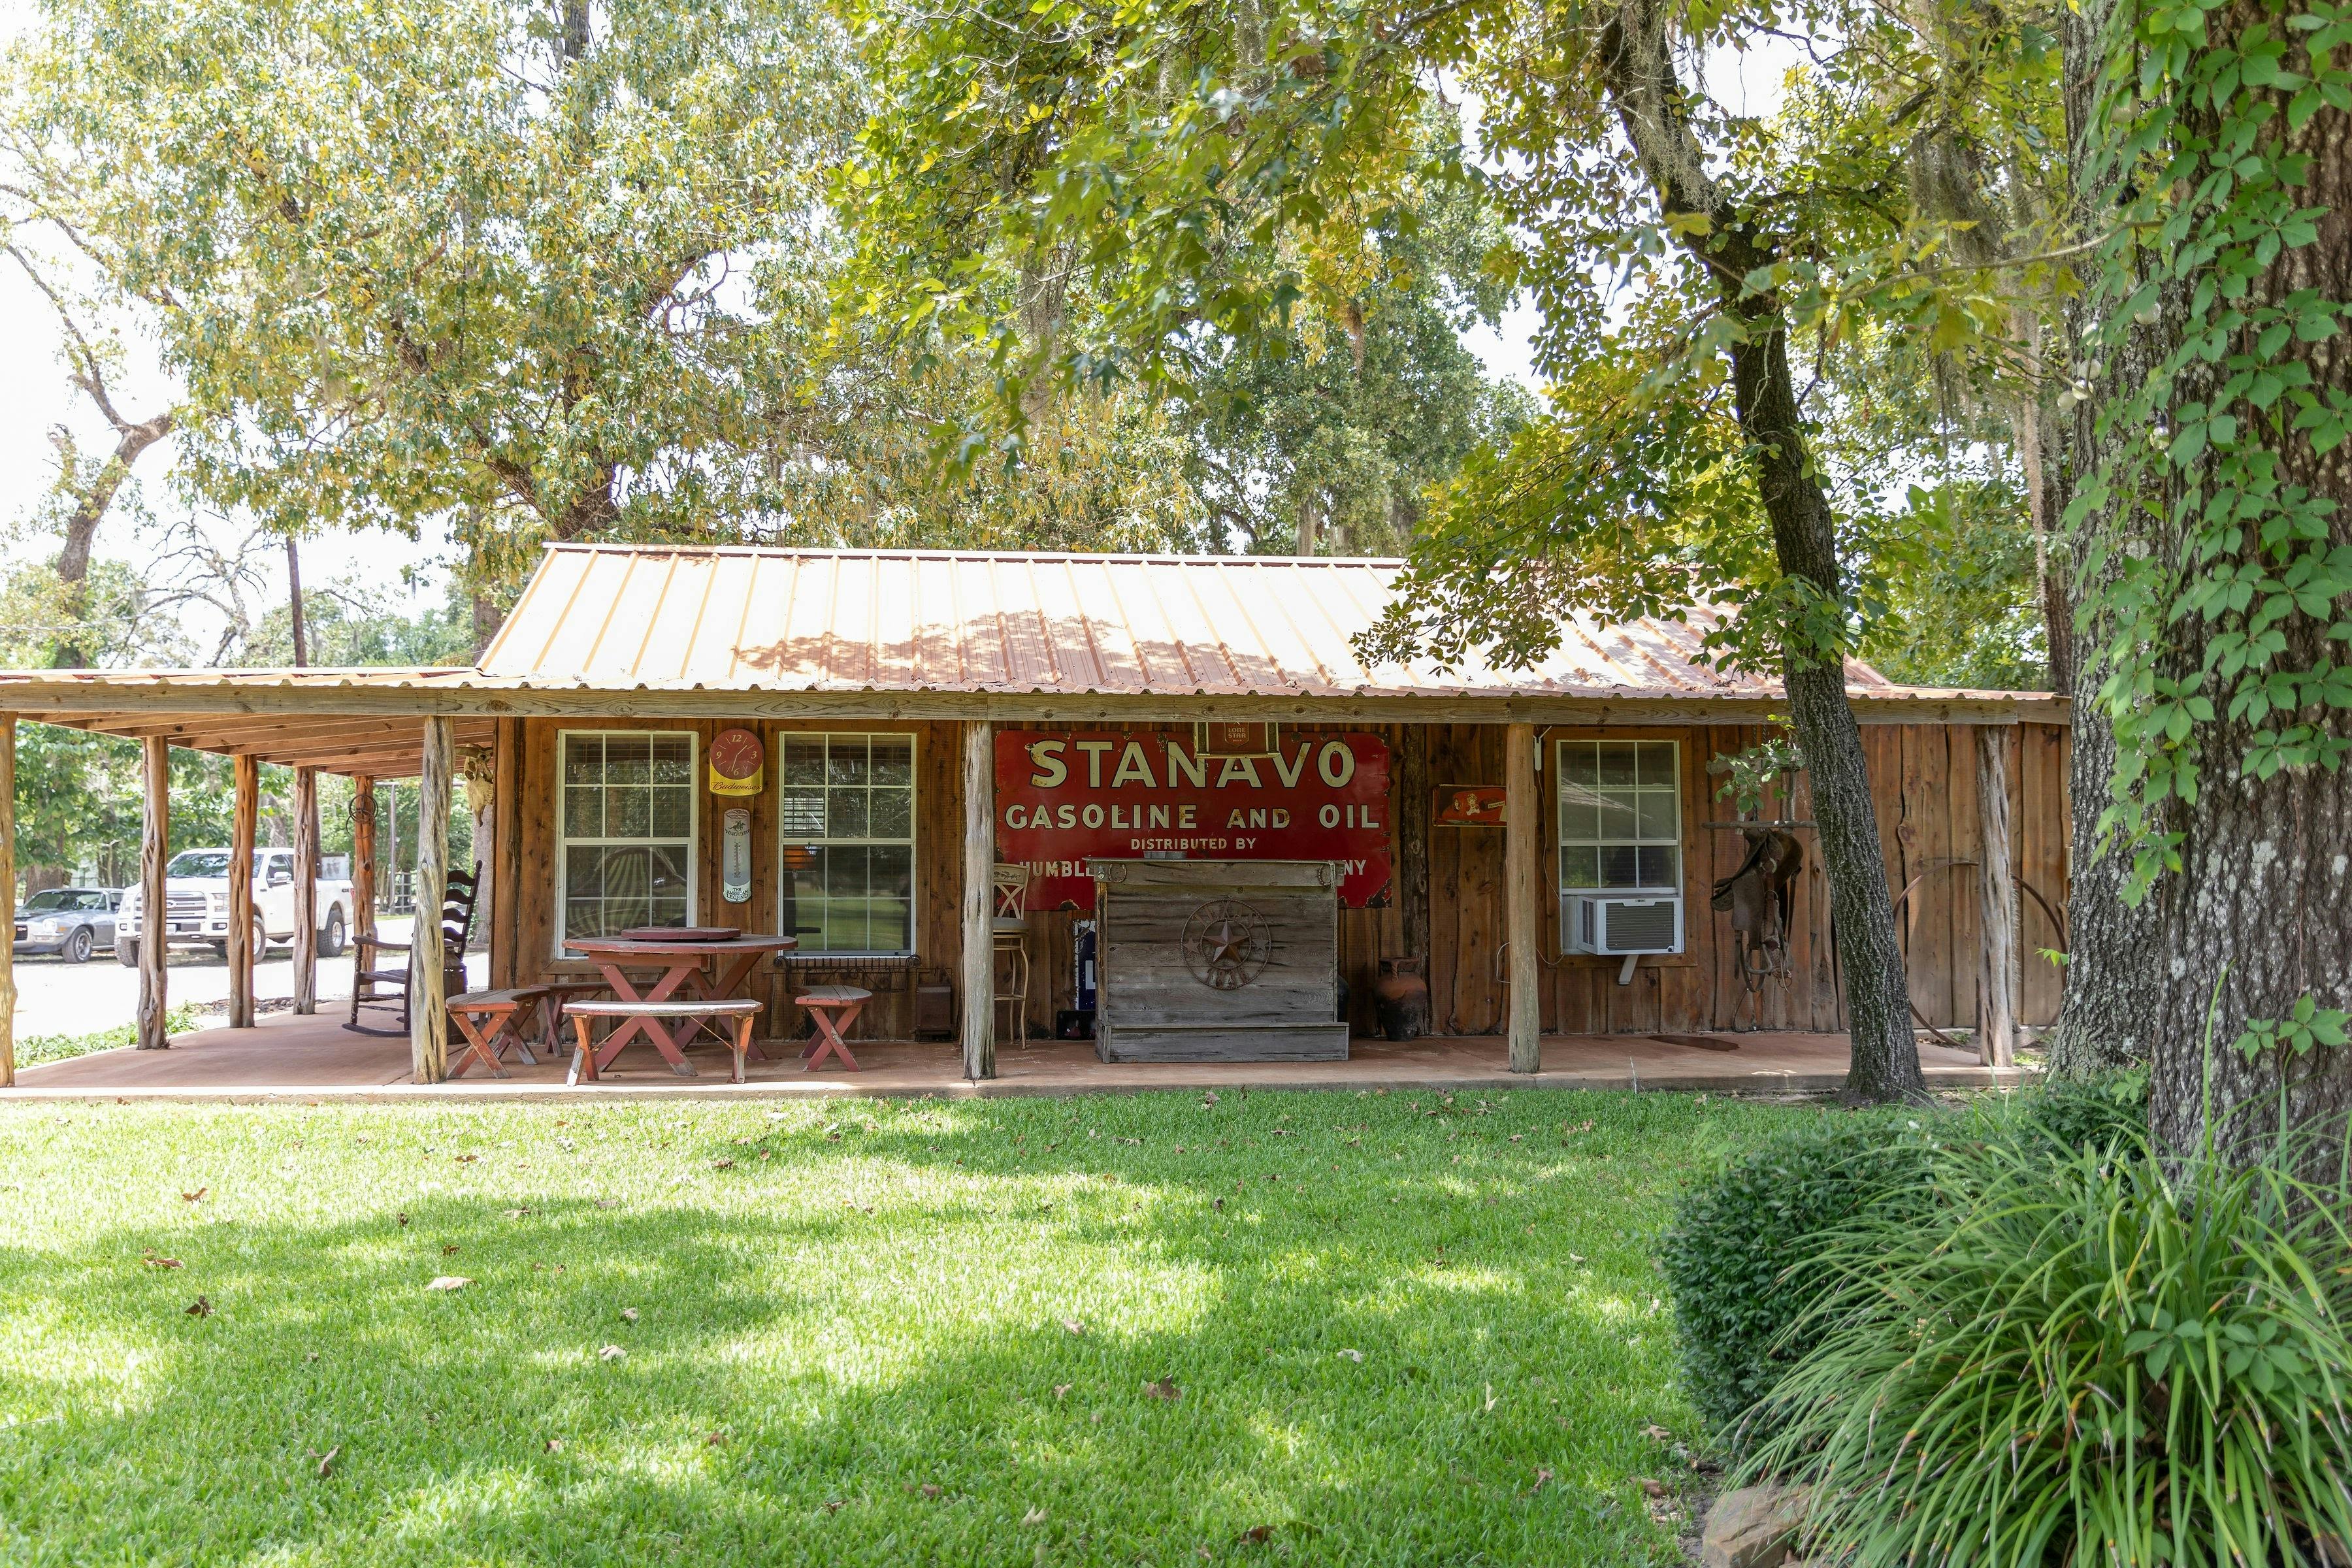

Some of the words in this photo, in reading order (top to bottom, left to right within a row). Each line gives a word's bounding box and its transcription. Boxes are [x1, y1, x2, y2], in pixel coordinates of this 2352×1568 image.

[1030, 740, 1356, 788] STANAVO
[1005, 804, 1197, 830] GASOLINE
[1226, 808, 1290, 828] AND
[1318, 804, 1380, 828] OIL
[1131, 838, 1227, 850] DISTRIBUTED
[1235, 838, 1256, 850] BY
